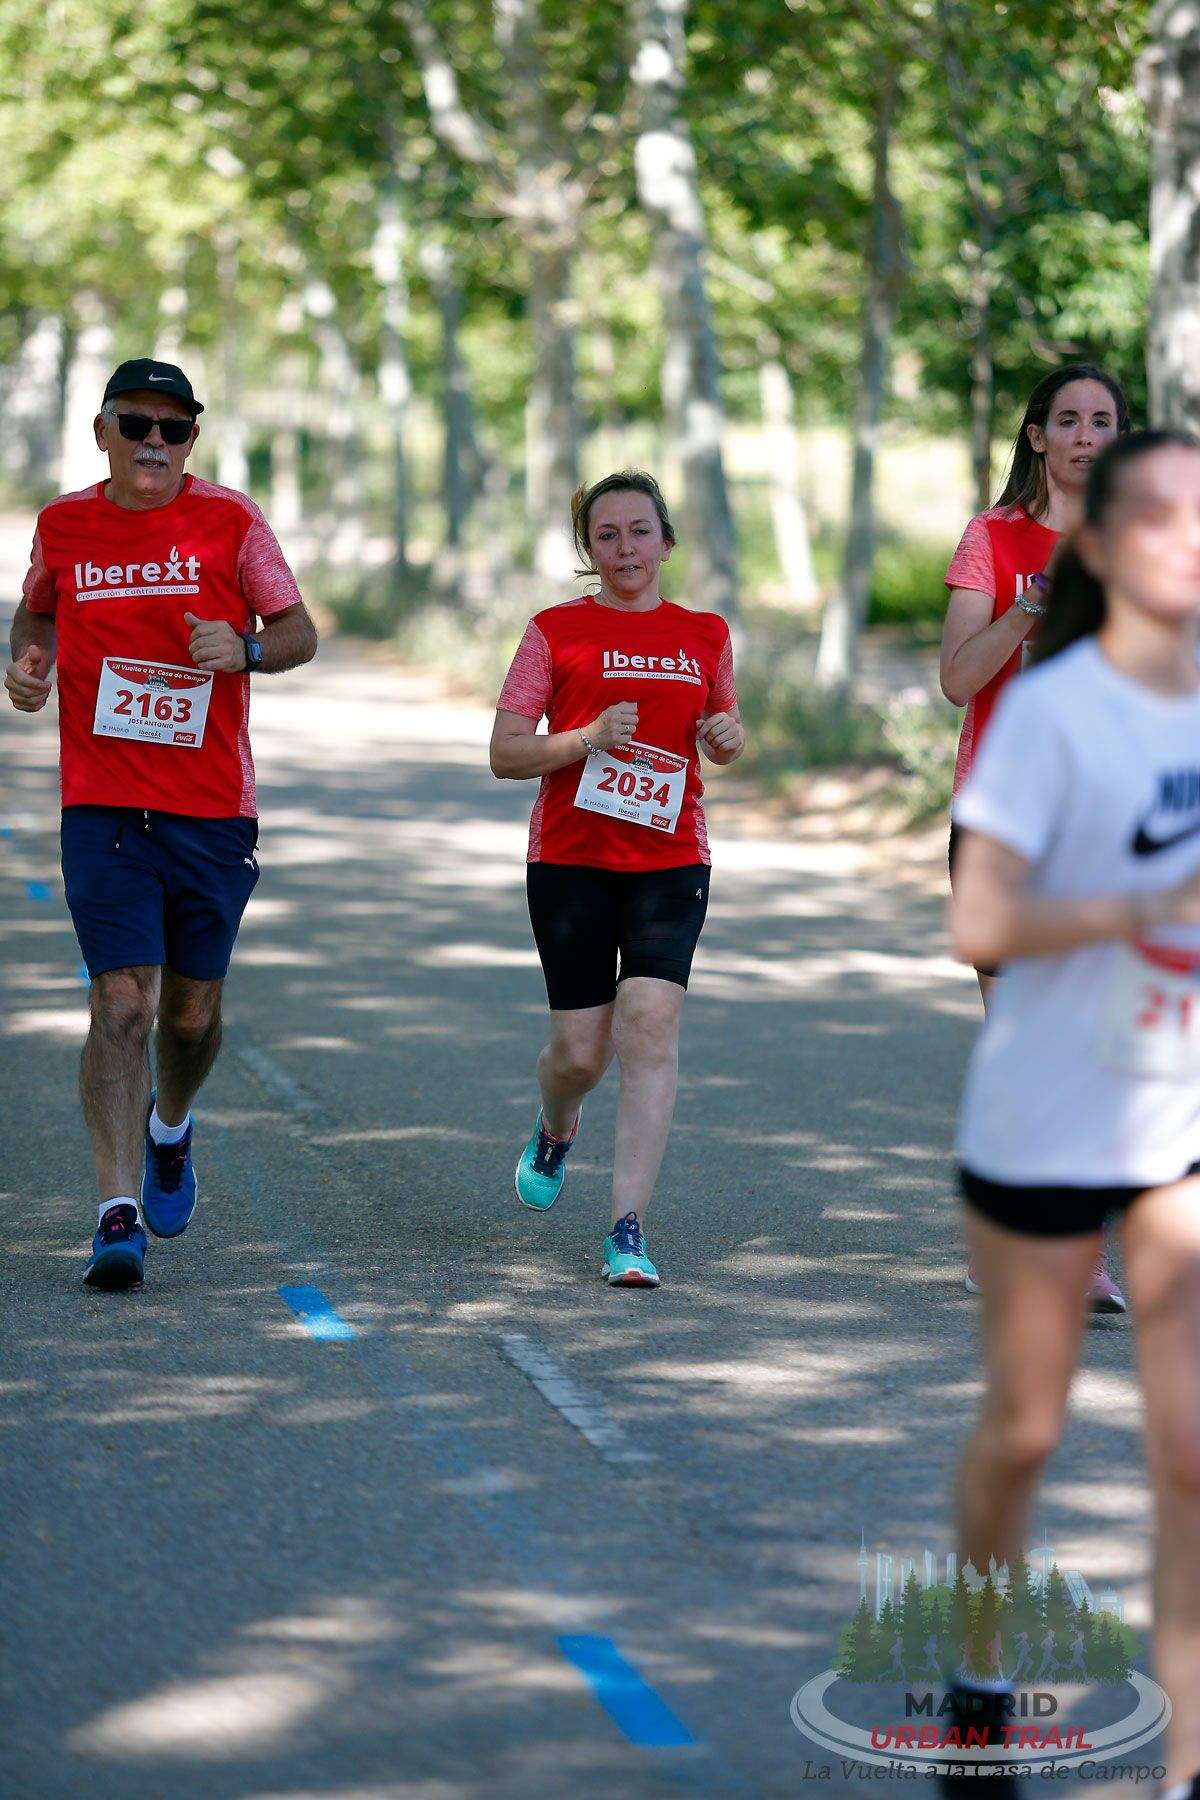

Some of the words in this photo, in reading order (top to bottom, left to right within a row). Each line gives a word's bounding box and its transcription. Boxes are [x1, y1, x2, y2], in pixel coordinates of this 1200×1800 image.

[75, 552, 200, 588] Iberext
[125, 588, 154, 596] Contra
[158, 585, 198, 594] Incendios
[603, 650, 701, 676] Iberext
[121, 664, 142, 673] Vuelta
[157, 669, 173, 677] Casa
[183, 674, 206, 683] Campo
[113, 689, 192, 723] 2163
[128, 718, 143, 726] JOSE
[144, 720, 174, 730] ANTONIO
[644, 751, 659, 760] Casa
[596, 766, 671, 808] 2034
[623, 798, 641, 808] GEMA
